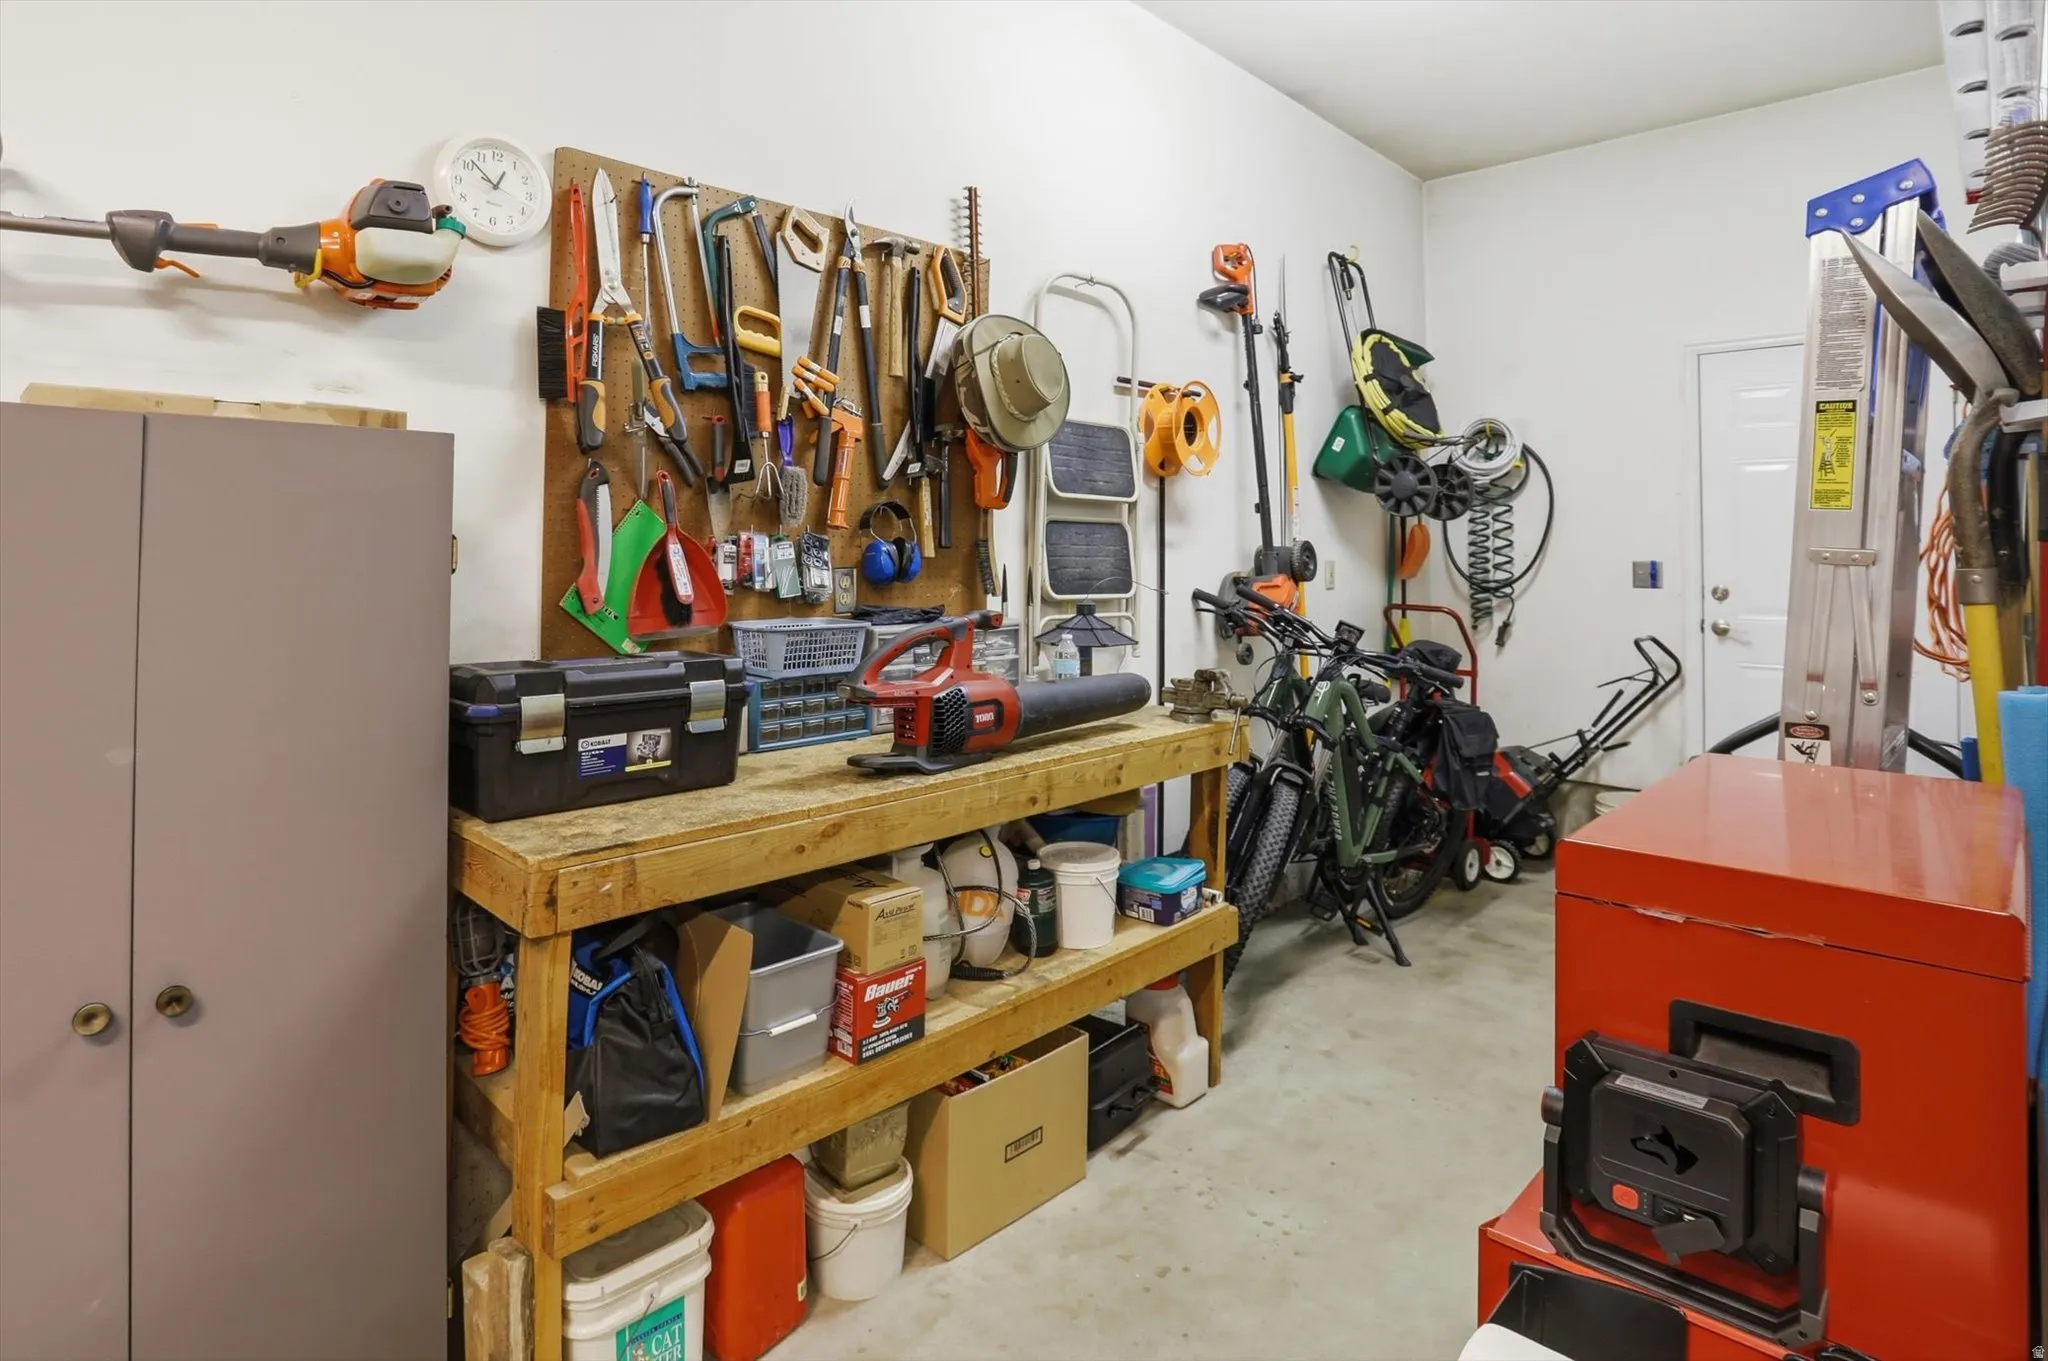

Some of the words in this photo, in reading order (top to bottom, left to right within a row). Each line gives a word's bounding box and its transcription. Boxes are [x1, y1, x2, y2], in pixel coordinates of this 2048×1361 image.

[477, 151, 486, 163] 11
[492, 151, 504, 162] 12
[463, 160, 475, 171] 10
[454, 175, 462, 185] 9
[521, 175, 529, 185] 2
[459, 192, 467, 202] 8
[525, 192, 533, 201] 3
[472, 207, 480, 218] 7
[489, 216, 497, 226] 6
[506, 216, 514, 225] 5
[592, 333, 600, 368] FISKARS
[1819, 402, 1854, 410] CAUTION
[976, 712, 994, 723] TORO
[590, 738, 612, 747] KOBALT
[573, 967, 603, 991] KOBAL
[863, 973, 915, 1003] Bauer
[652, 1323, 682, 1355] CAT
